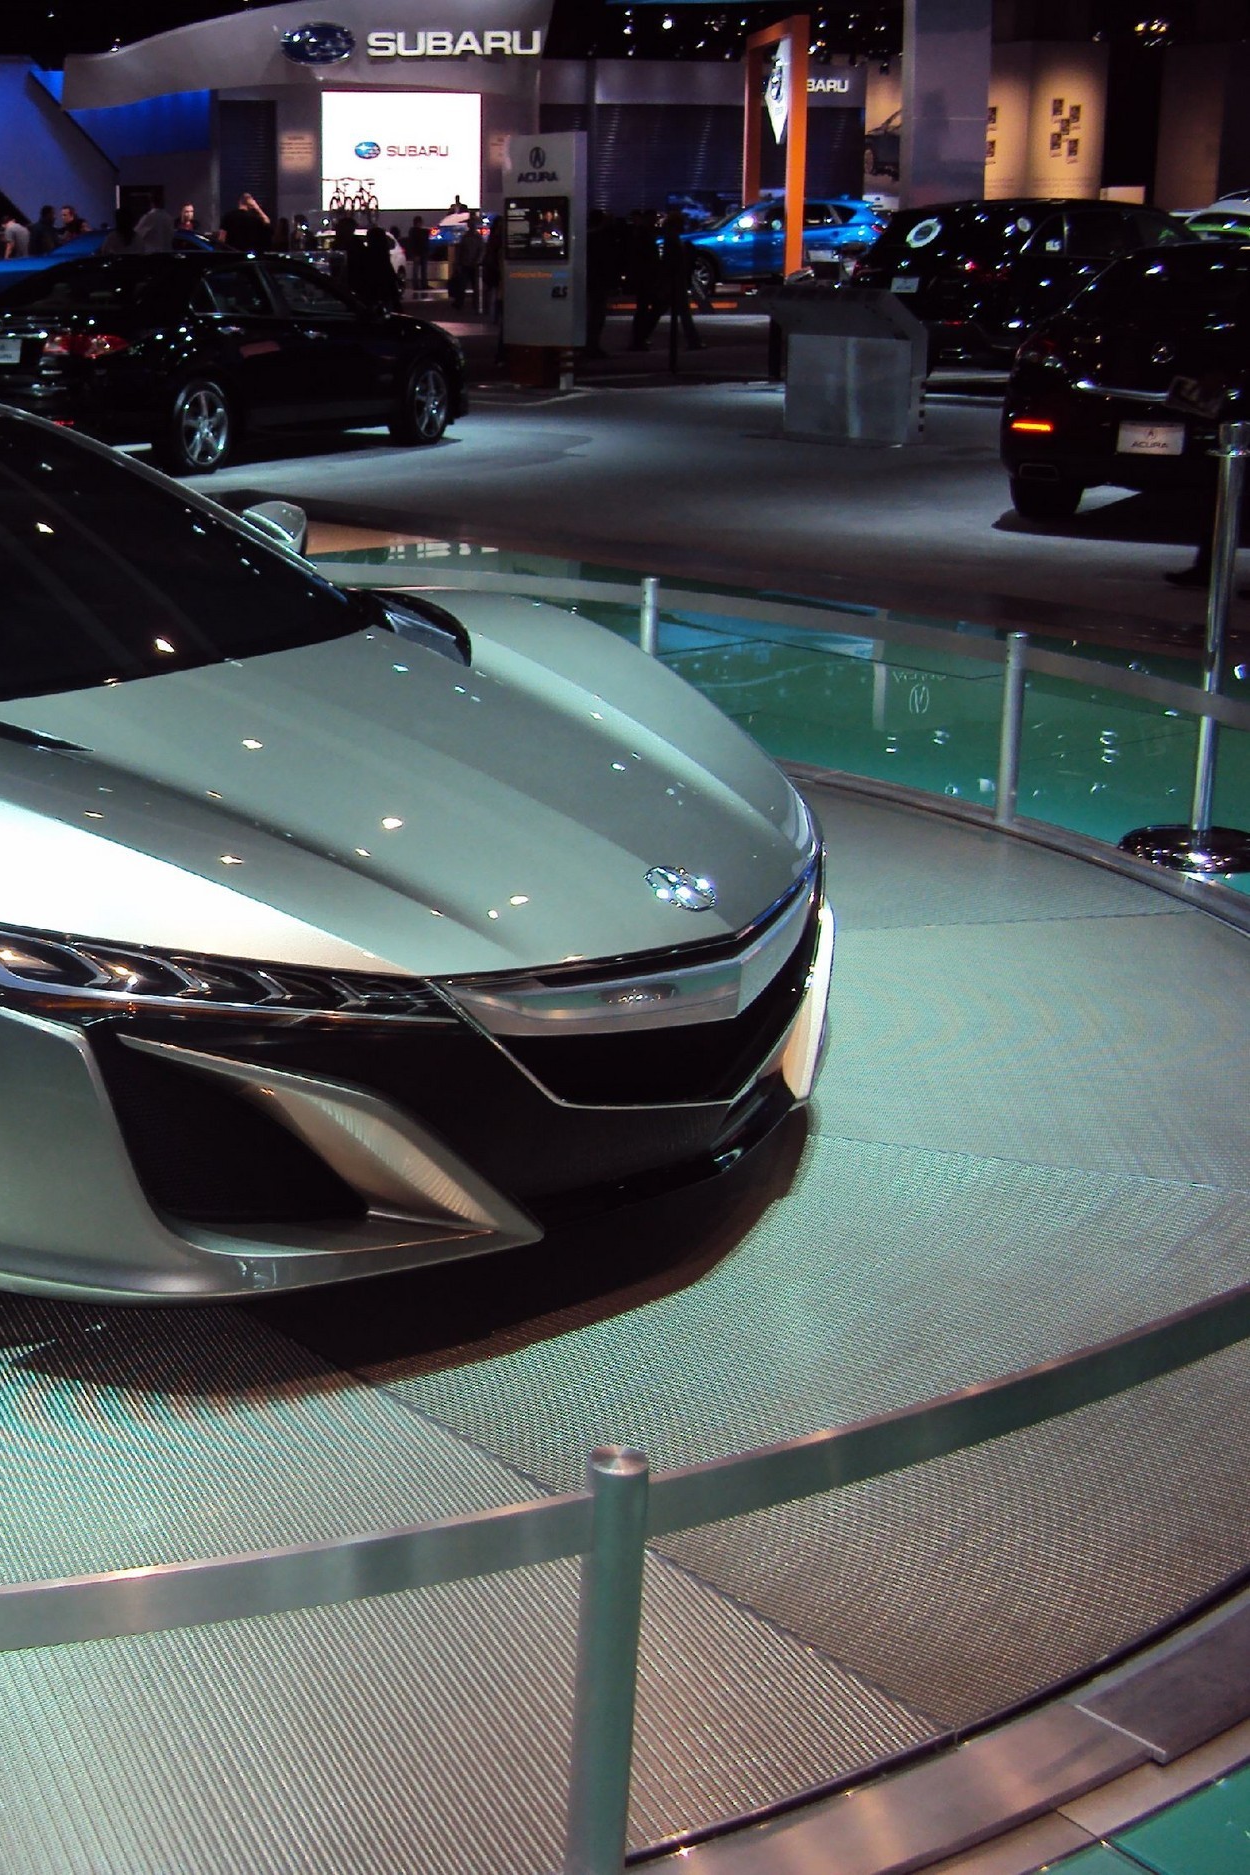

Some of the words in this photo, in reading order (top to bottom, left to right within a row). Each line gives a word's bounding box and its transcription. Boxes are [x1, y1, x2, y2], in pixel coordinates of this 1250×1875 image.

[367, 30, 541, 57] SUBARU
[806, 78, 850, 93] BARU
[387, 145, 449, 157] SUBARU
[517, 171, 558, 183] ACURA
[1130, 441, 1169, 449] ACURA
